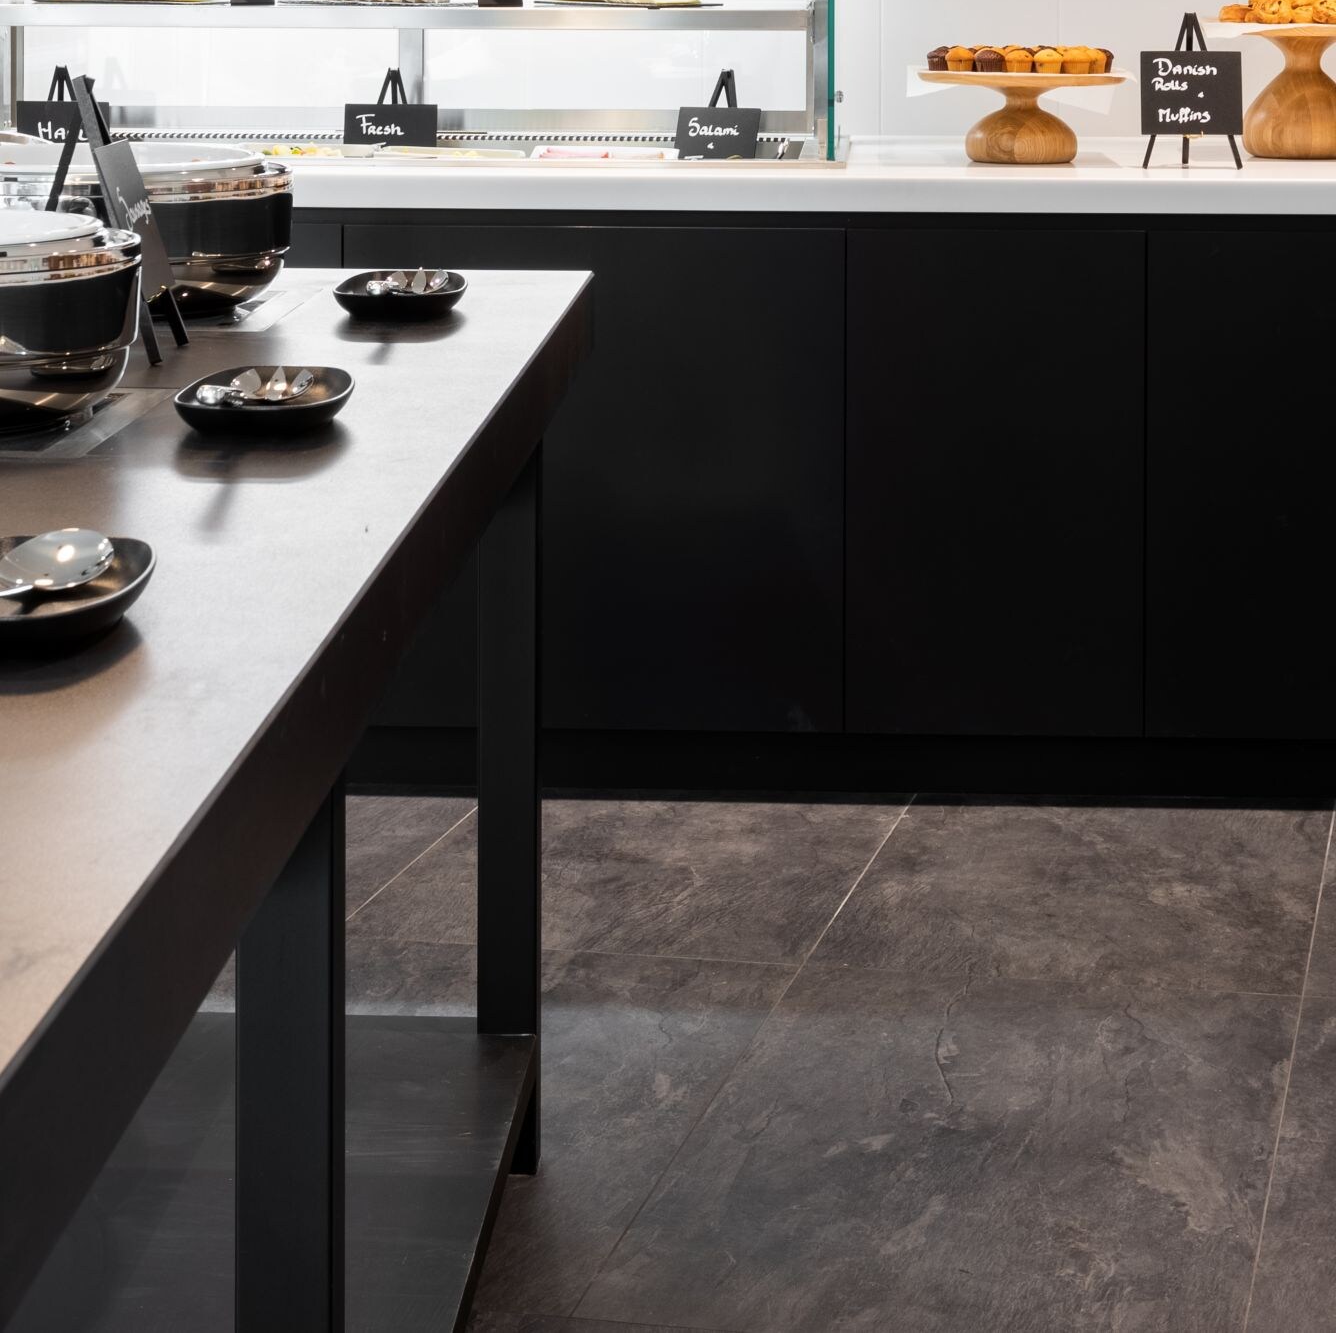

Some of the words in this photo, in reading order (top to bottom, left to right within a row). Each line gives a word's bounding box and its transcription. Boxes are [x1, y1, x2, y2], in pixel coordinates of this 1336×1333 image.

[1152, 57, 1218, 77] Danish
[1151, 77, 1189, 92] Rolls
[356, 113, 405, 136] Fresh
[1157, 106, 1212, 124] Muffins
[688, 116, 740, 137] Salami
